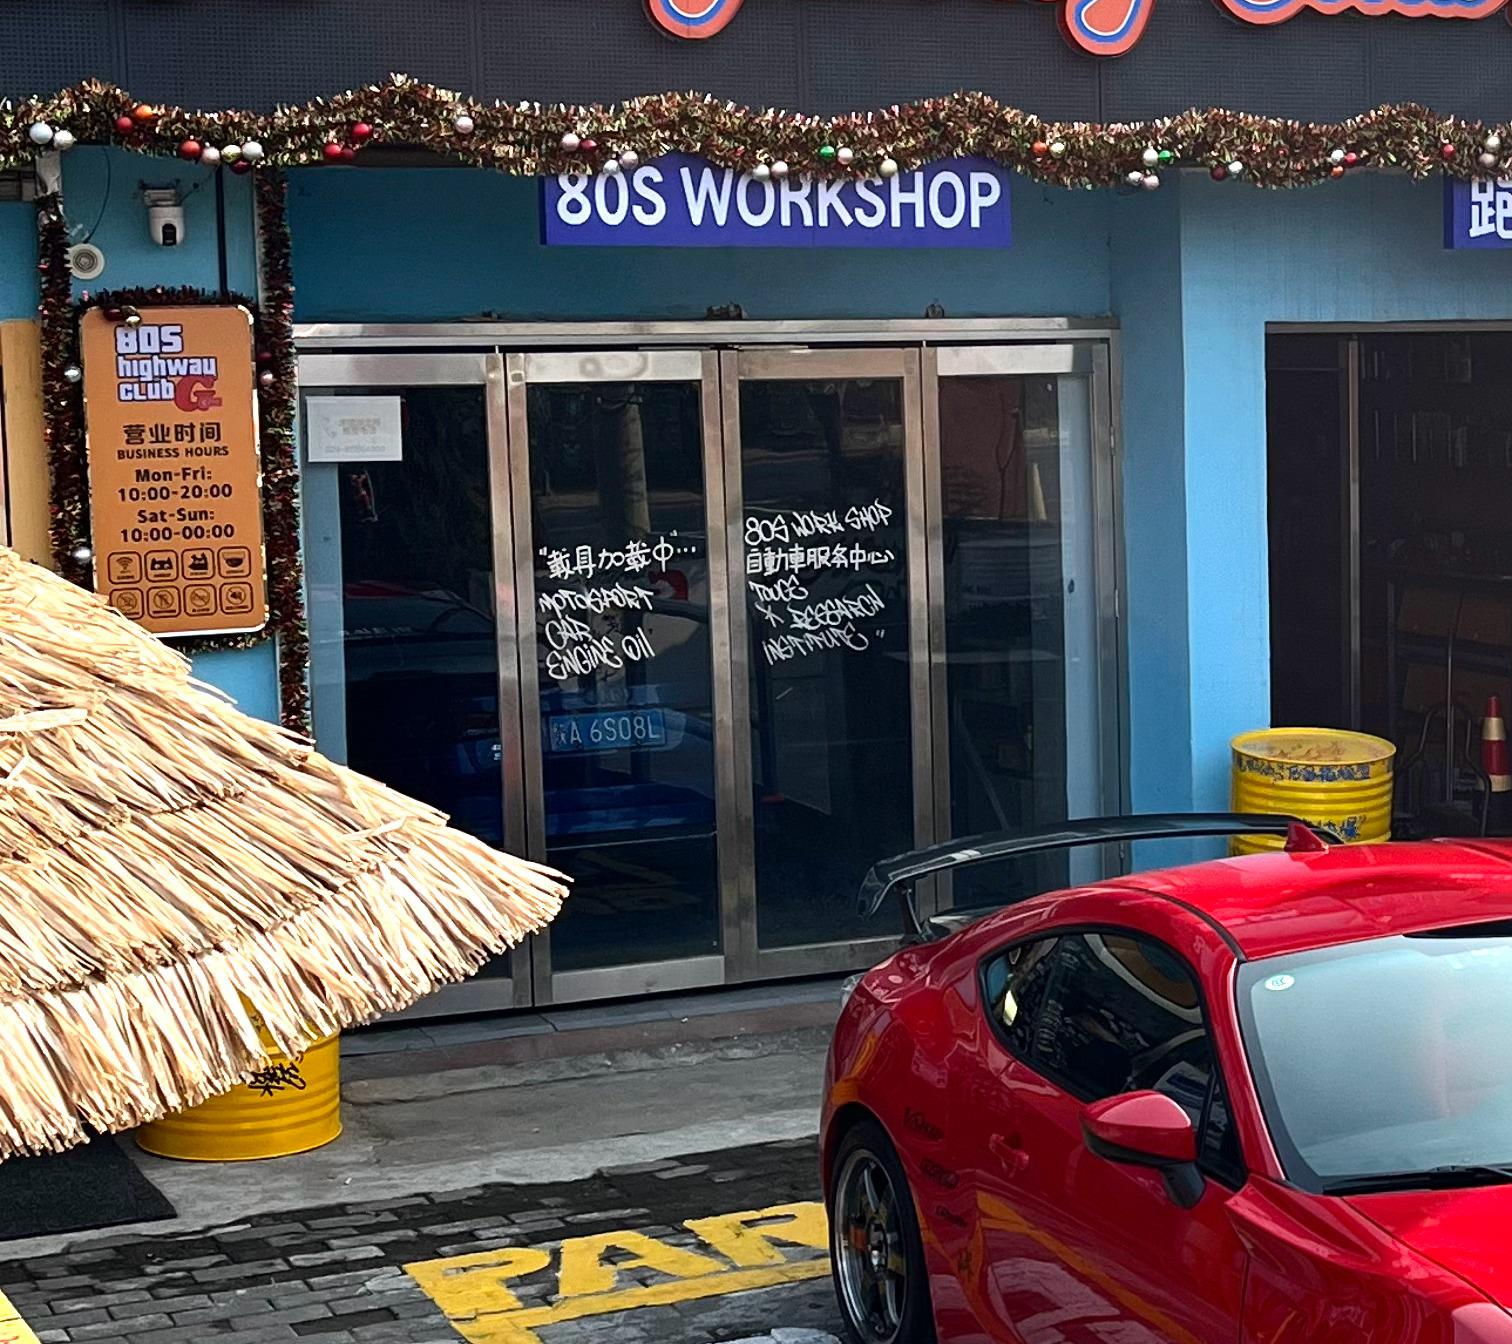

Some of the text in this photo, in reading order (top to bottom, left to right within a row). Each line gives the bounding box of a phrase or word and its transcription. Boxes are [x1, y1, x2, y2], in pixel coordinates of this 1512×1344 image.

[557, 167, 1001, 228] 80S WORKSHOP
[115, 324, 183, 354] 80S
[122, 422, 221, 446] 营业时间
[117, 446, 229, 460] BUSINESS HOURS
[135, 467, 212, 483] Mon-Fri:
[118, 483, 232, 502] 10:00-20:00
[137, 508, 214, 523] Sat-Sun:
[744, 498, 893, 545] 80S WORK SHOP
[120, 524, 235, 543] 10:00-00:00
[545, 614, 594, 650] CAR
